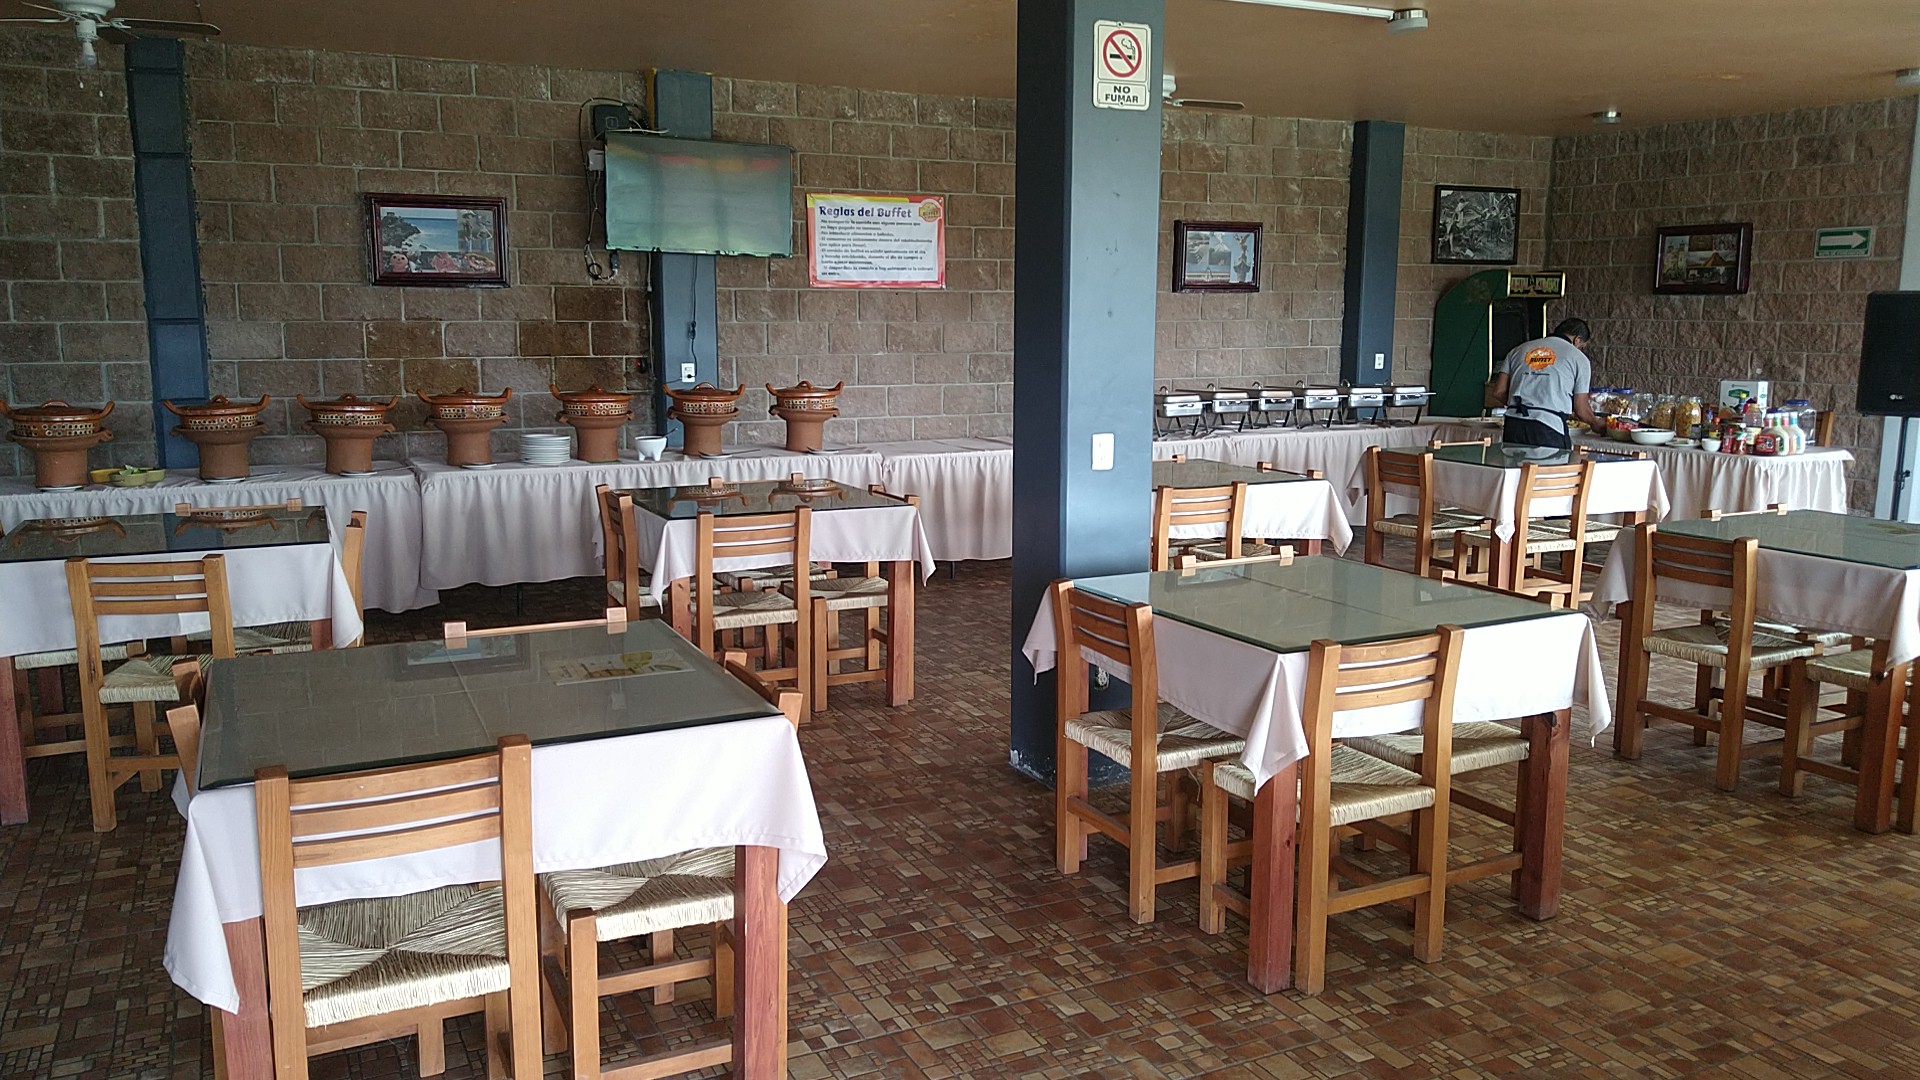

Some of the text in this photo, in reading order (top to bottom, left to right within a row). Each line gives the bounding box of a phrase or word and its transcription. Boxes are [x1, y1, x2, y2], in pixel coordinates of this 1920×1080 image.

[1113, 85, 1131, 94] NO
[1105, 93, 1139, 103] FUMAR
[819, 206, 855, 219] Reglas
[857, 207, 874, 217] del
[877, 207, 912, 218] Buffet
